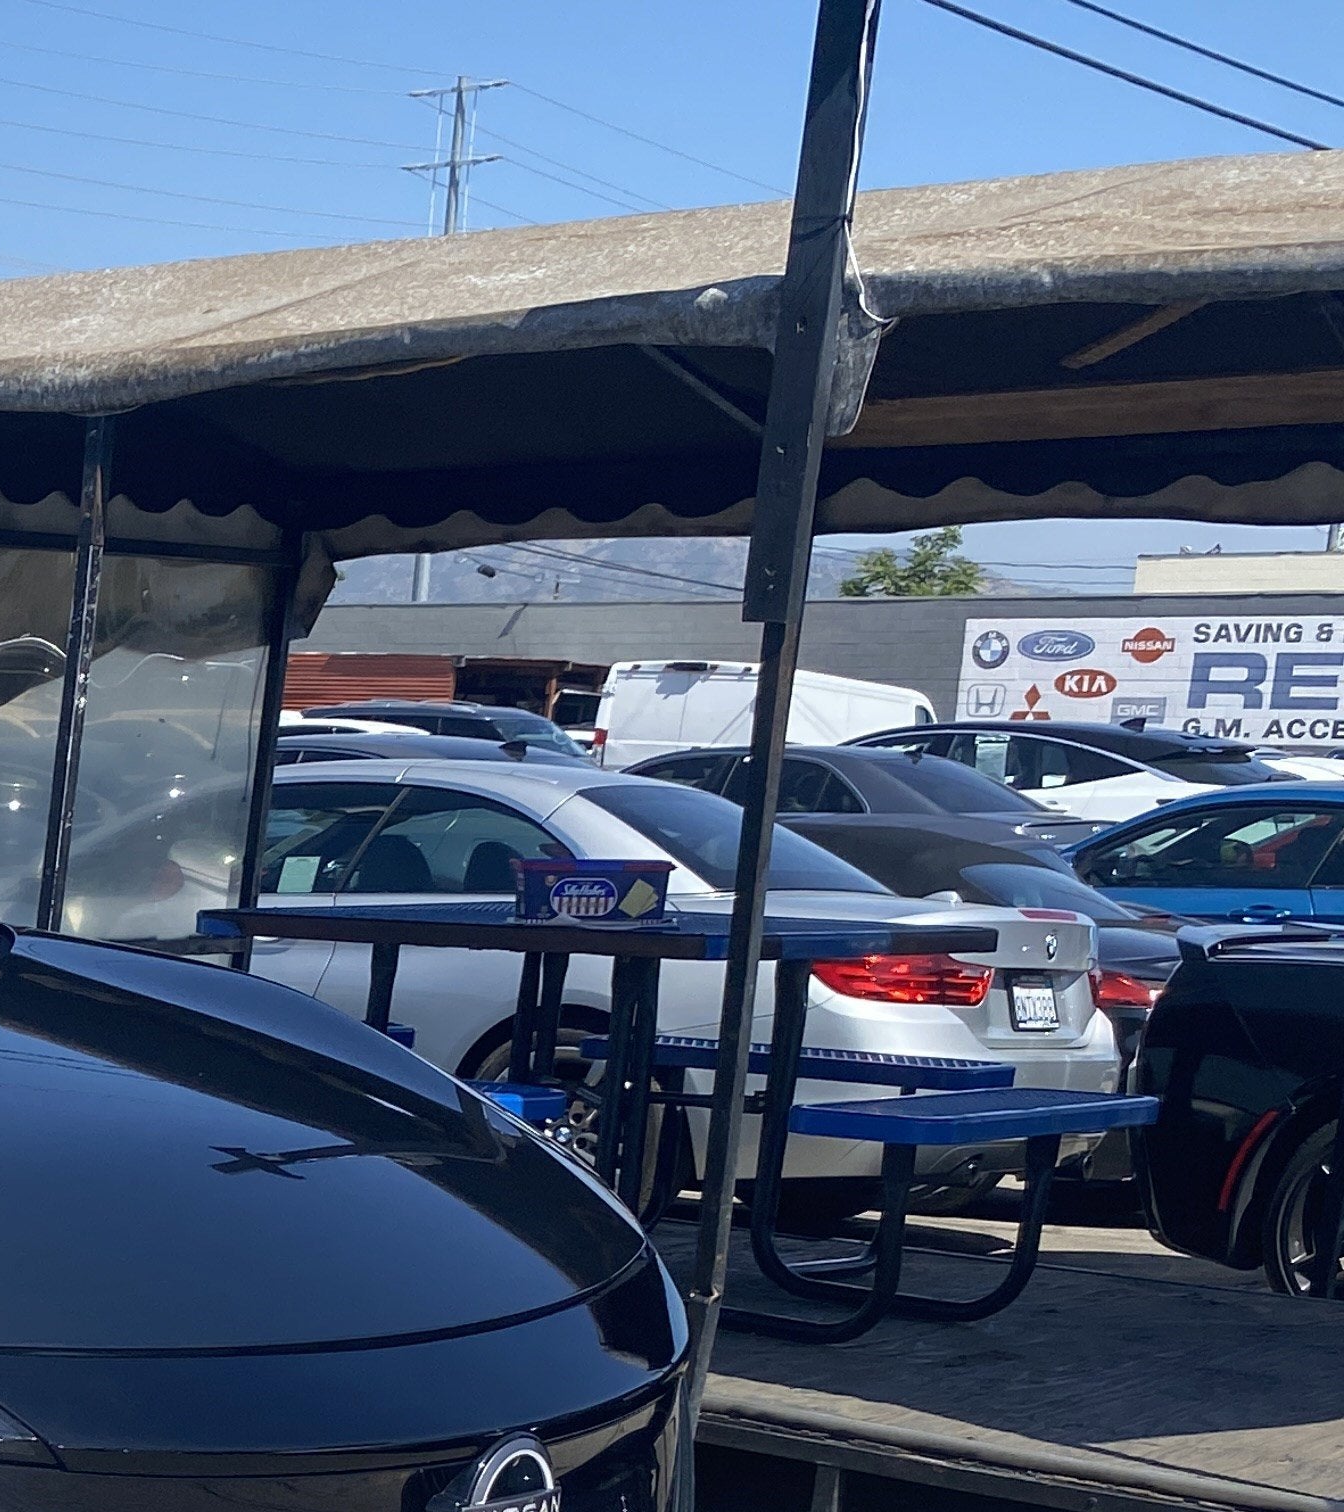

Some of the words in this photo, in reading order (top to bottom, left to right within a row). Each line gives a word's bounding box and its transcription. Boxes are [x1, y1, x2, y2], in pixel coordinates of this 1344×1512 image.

[1193, 622, 1304, 643] SAVING
[1315, 622, 1334, 643] &
[1033, 636, 1079, 655] Ford
[1124, 639, 1173, 651] NISSAN
[1063, 674, 1109, 693] KIA
[1117, 704, 1160, 716] GMC
